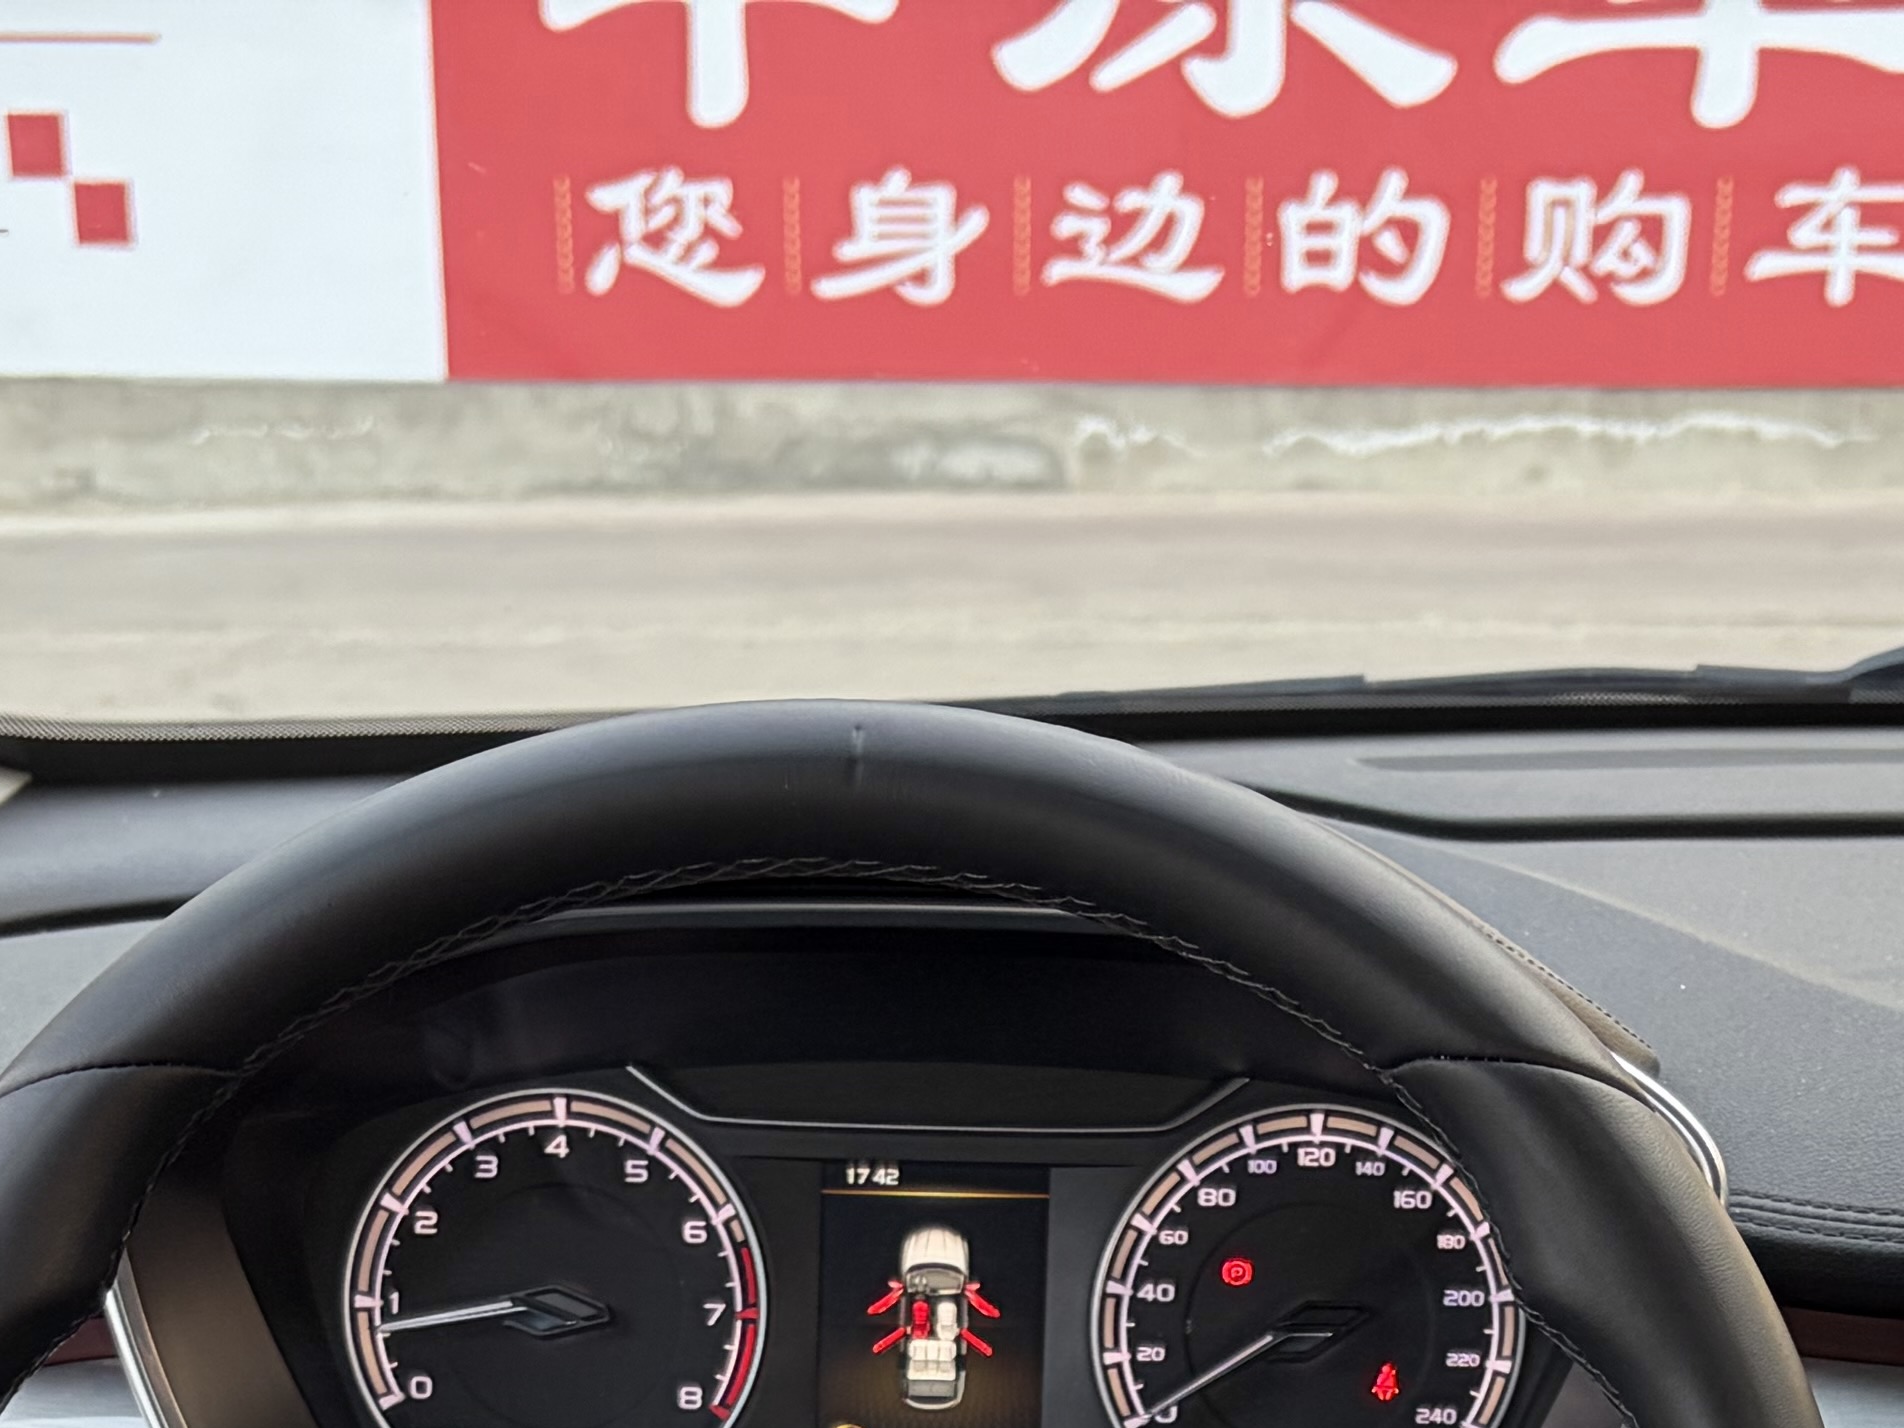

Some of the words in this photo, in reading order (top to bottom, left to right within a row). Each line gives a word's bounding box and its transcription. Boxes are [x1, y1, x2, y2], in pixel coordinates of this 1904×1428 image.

[545, 1136, 568, 1158] 4
[475, 1155, 498, 1179] 3
[1248, 1159, 1277, 1175] 100
[1298, 1148, 1336, 1168] 120
[625, 1161, 648, 1183] 5
[1355, 1161, 1385, 1177] 140
[1198, 1189, 1235, 1207] 80
[1394, 1190, 1432, 1210] 160
[414, 1211, 438, 1234] 2
[682, 1221, 707, 1243] 6
[1159, 1229, 1189, 1245] 60
[1437, 1234, 1465, 1250] 180
[388, 1291, 400, 1314] 1
[1137, 1284, 1175, 1302] 40
[1443, 1290, 1485, 1307] 200
[703, 1303, 726, 1326] 7
[1137, 1347, 1165, 1362] 20
[1446, 1353, 1480, 1368] 220
[409, 1377, 433, 1399] 0
[678, 1387, 703, 1410] 8
[1415, 1409, 1457, 1425] 240
